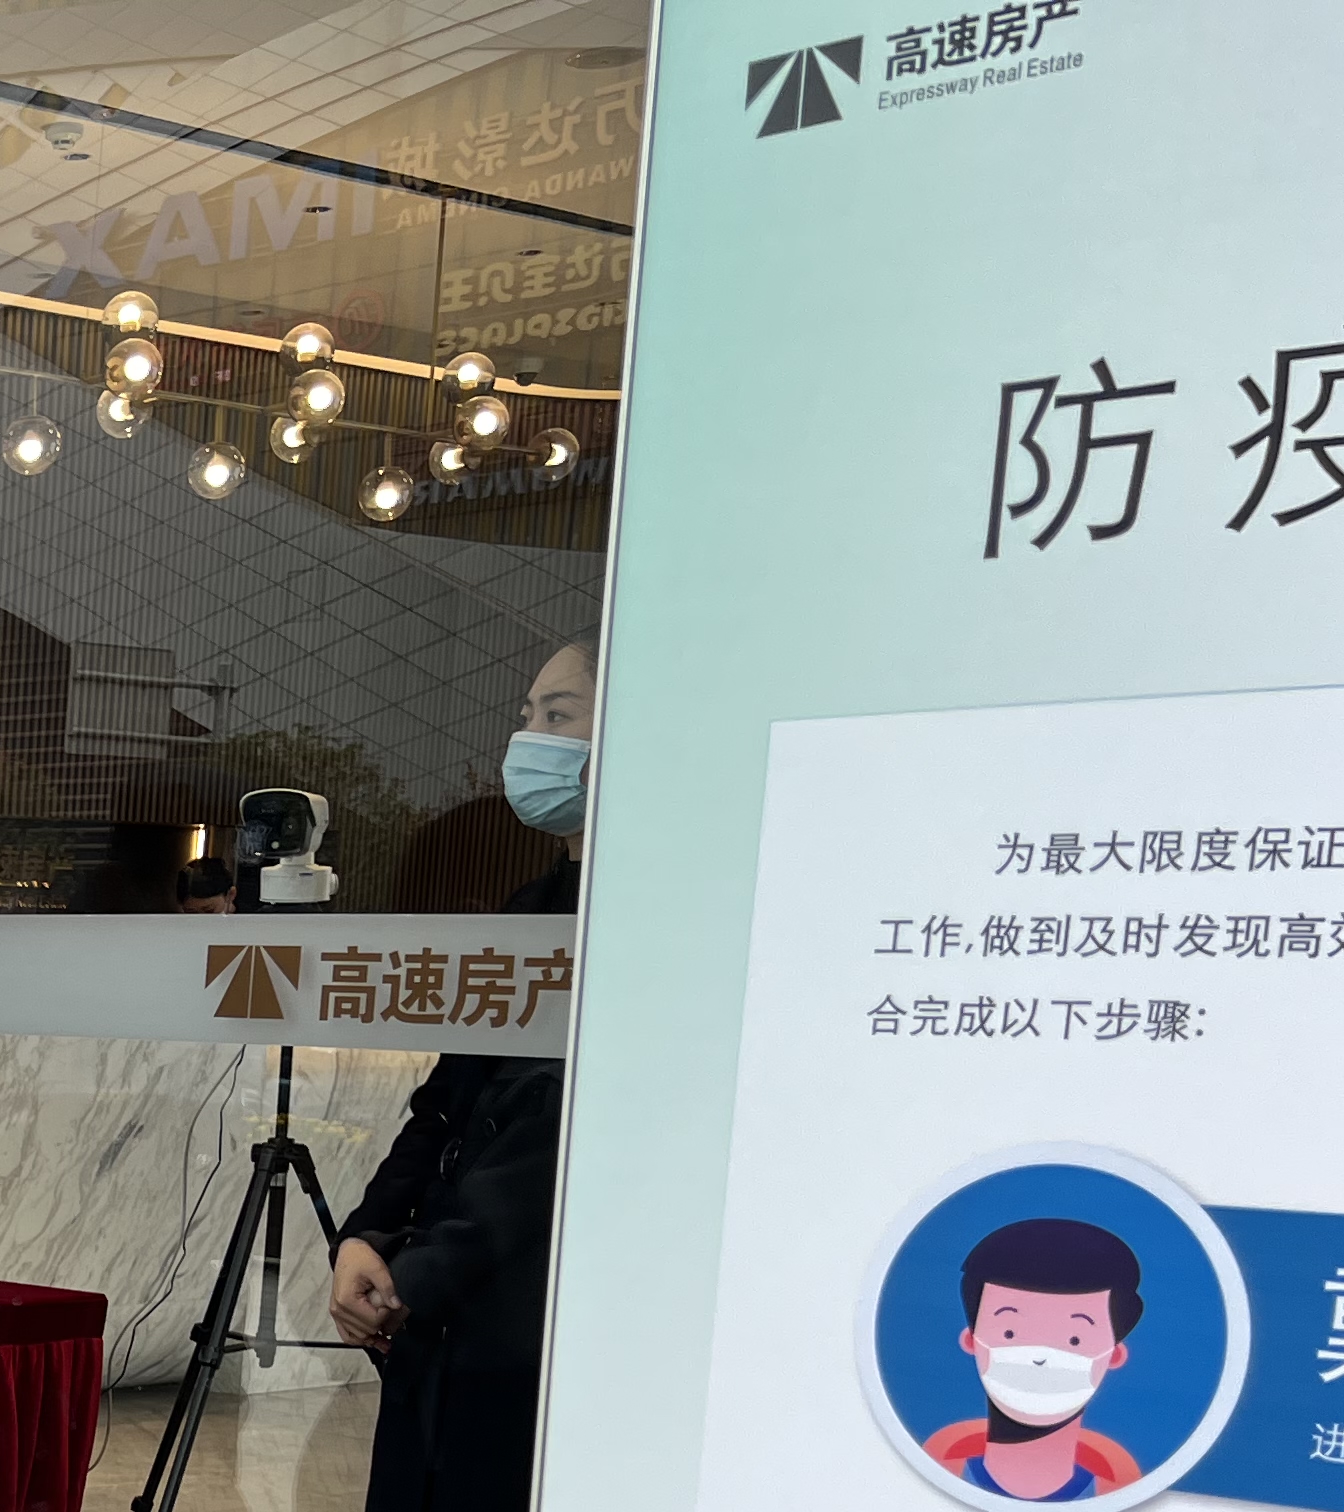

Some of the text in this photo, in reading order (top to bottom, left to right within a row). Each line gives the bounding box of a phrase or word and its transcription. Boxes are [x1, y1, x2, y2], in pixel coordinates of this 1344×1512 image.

[886, 0, 1080, 81] 高速房产
[878, 51, 1084, 110] Expressway Real Estate
[995, 826, 1344, 876] 为最大限度保证
[318, 945, 574, 1029] 高速房产
